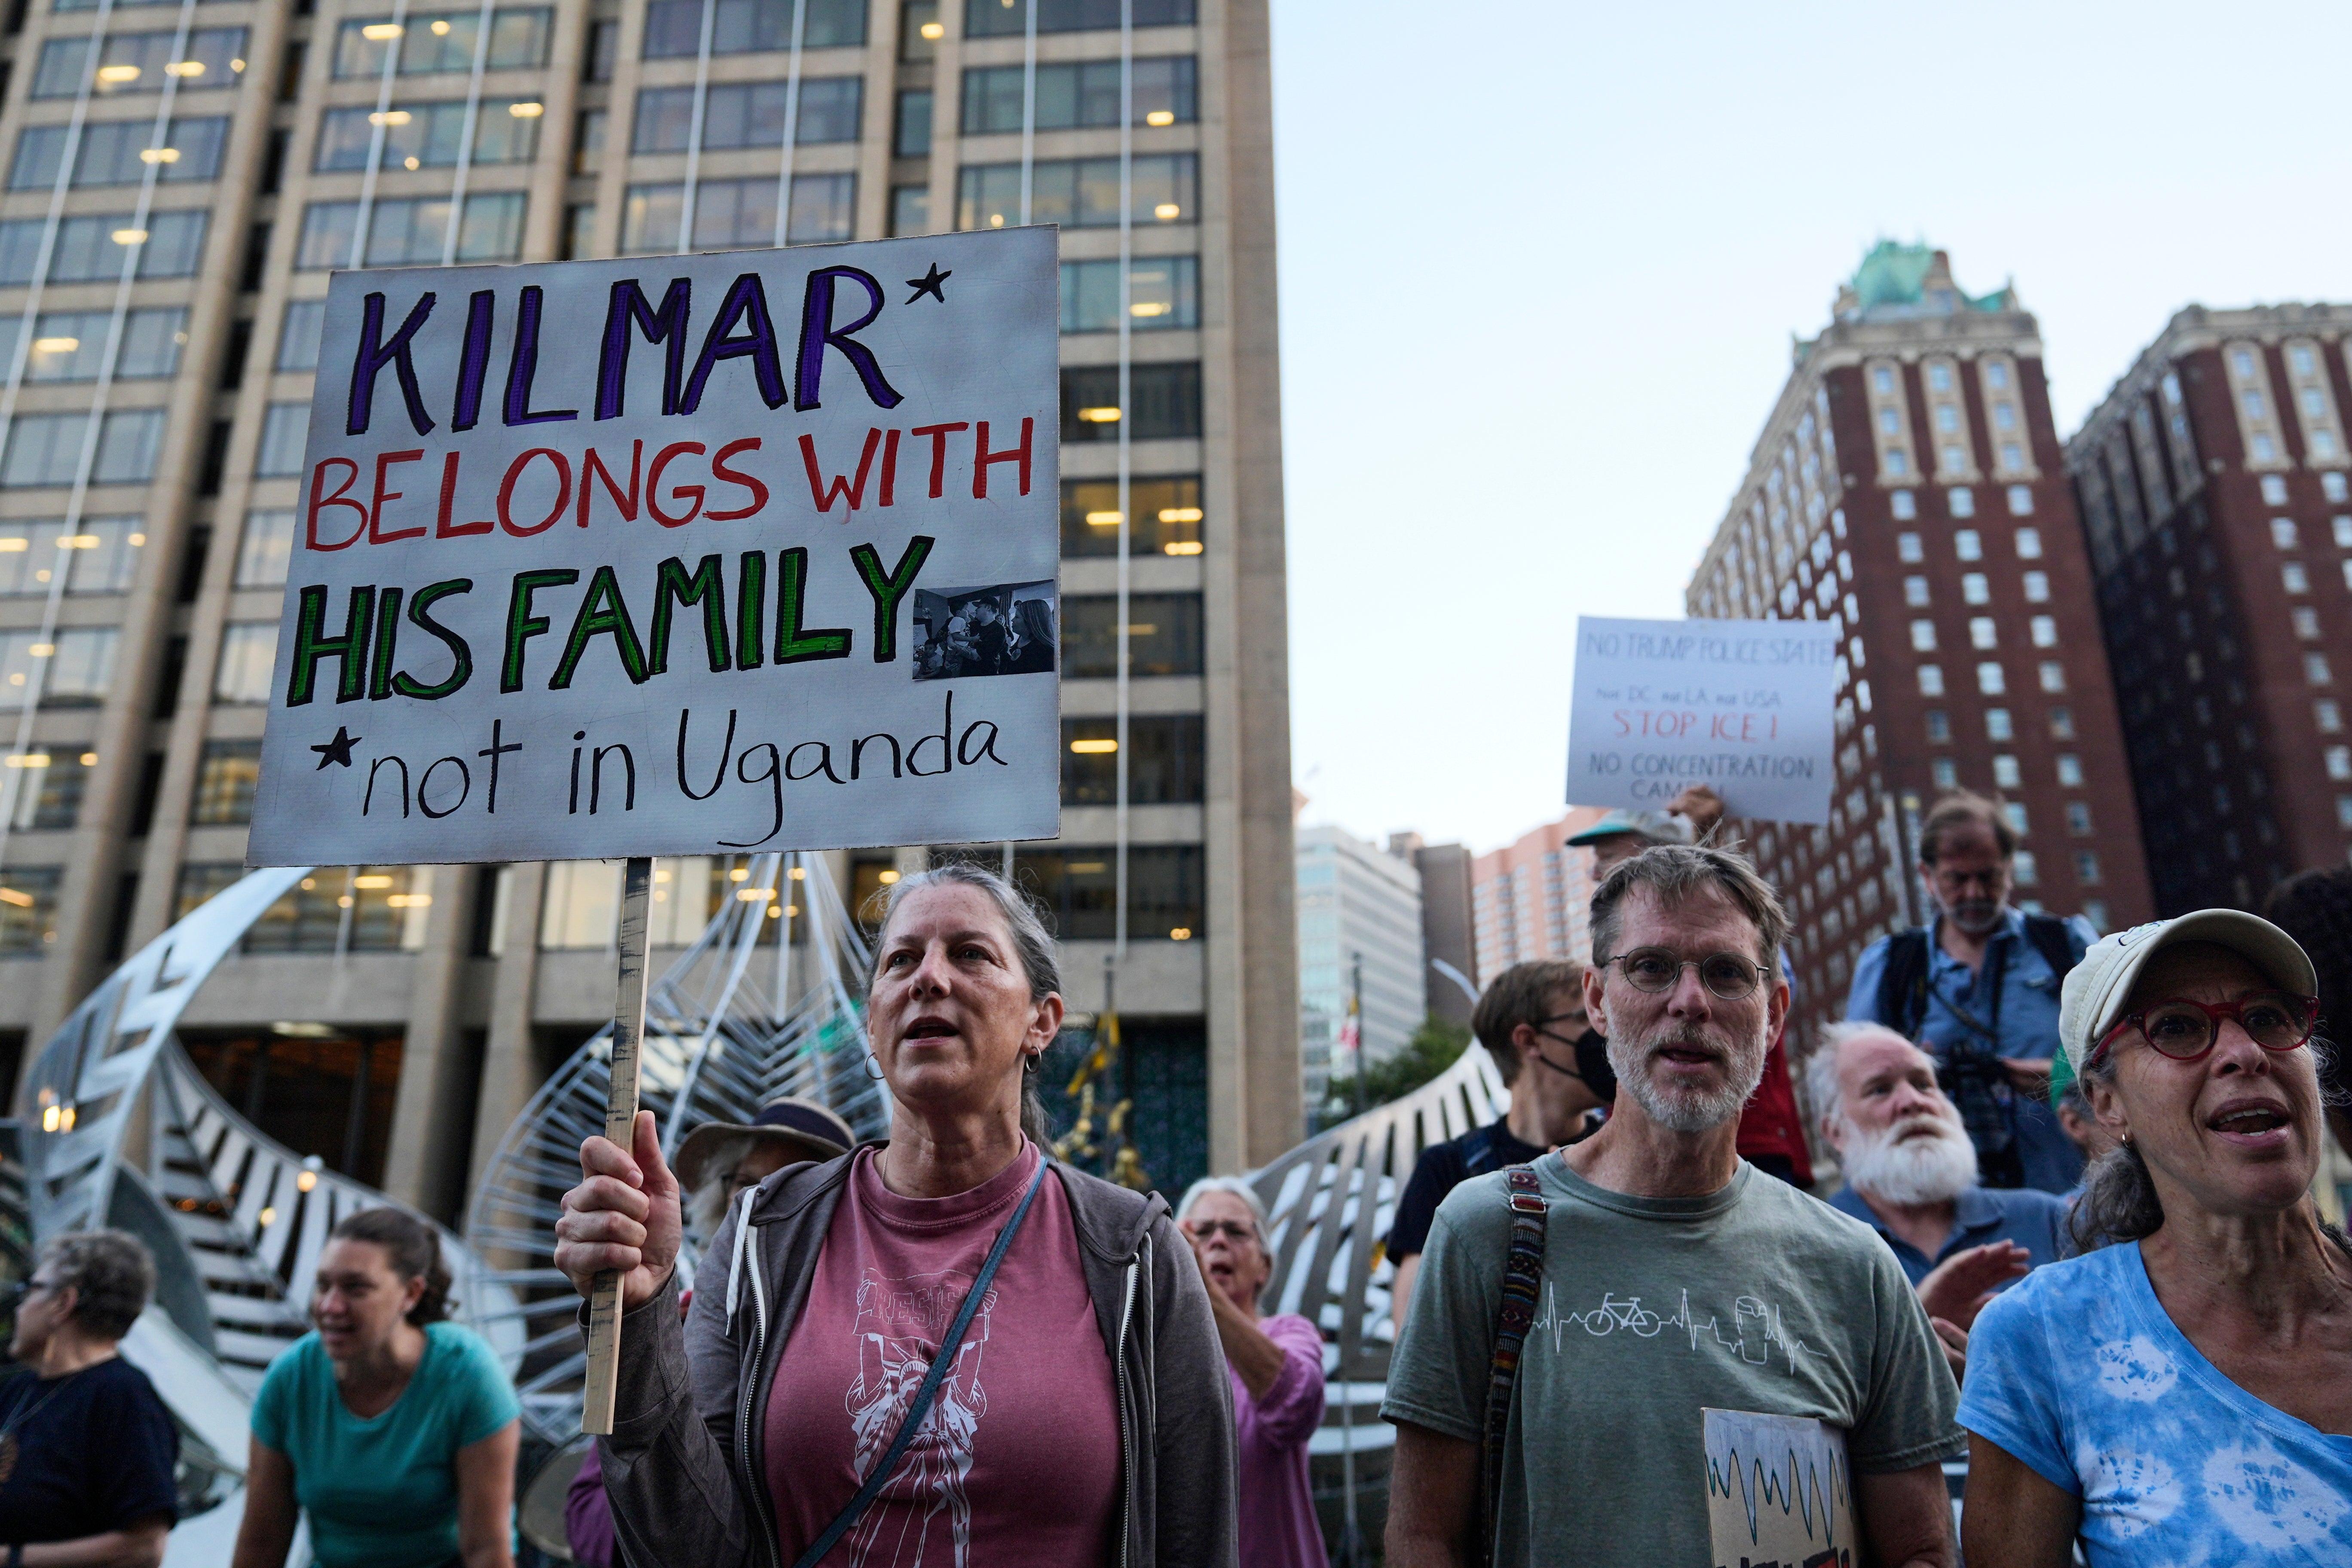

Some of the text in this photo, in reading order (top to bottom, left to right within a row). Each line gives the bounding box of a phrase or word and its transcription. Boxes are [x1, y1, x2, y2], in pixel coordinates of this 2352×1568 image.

[346, 264, 904, 436] KILMAR
[305, 417, 1033, 552] BELONGS WITH
[286, 535, 936, 708] HIS FAMILY
[1586, 632, 1834, 667] NO TRUMP POLICE STATE
[1628, 685, 1652, 703] DC
[1684, 686, 1710, 706] LA
[1743, 689, 1782, 709] USA
[1613, 708, 1697, 739] STOP
[363, 690, 1008, 848] not in Uganda
[1589, 751, 1815, 781] NO CONCENTRATION
[870, 1282, 971, 1329] RESIS
